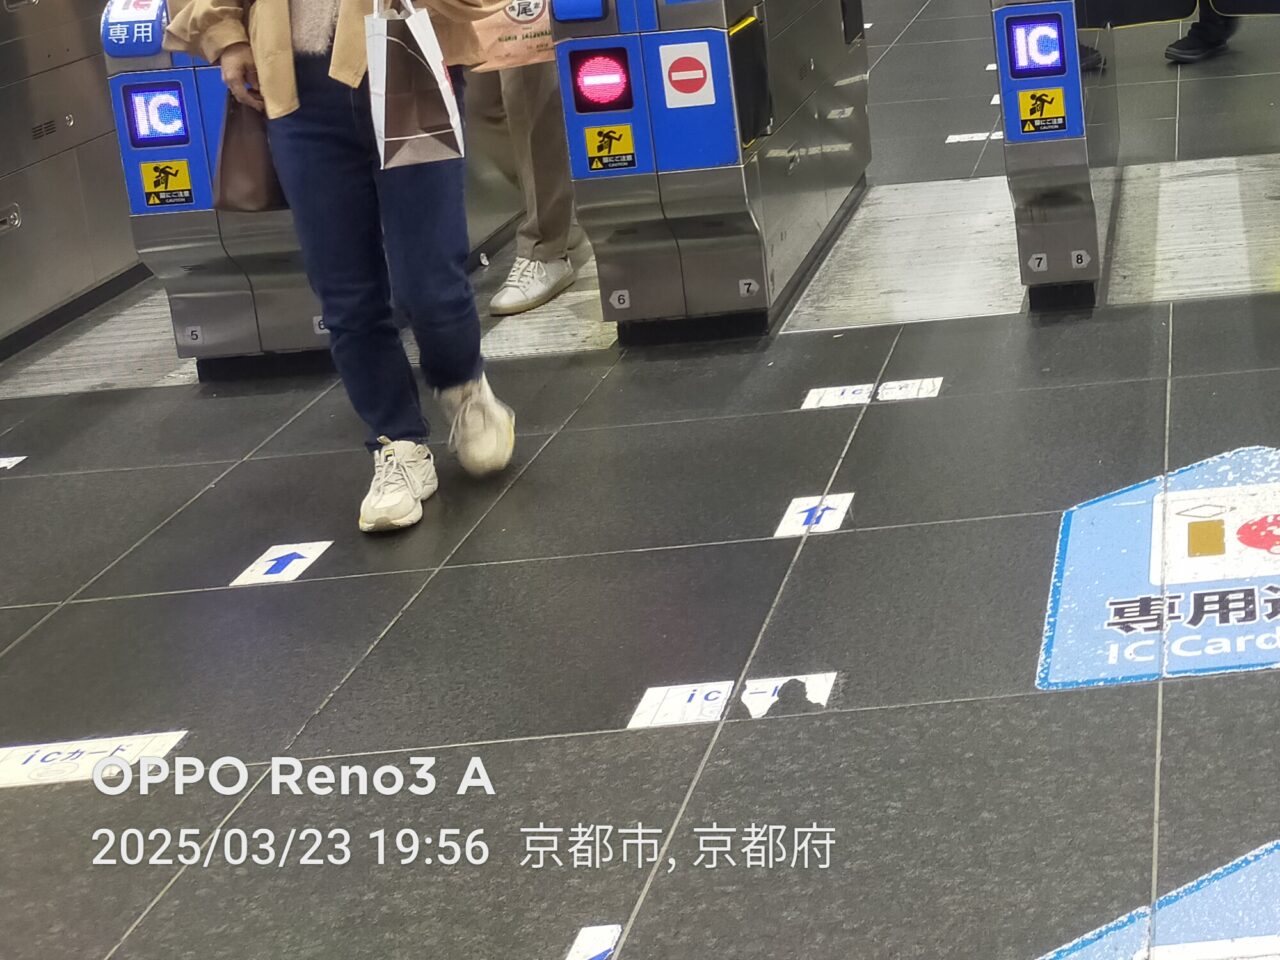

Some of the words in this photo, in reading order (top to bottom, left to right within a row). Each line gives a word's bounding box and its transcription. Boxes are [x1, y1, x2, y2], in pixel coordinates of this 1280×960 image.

[108, 22, 153, 45] 専用
[1015, 25, 1060, 67] IC
[132, 93, 182, 138] IC
[1034, 257, 1043, 268] 7
[1075, 253, 1084, 265] 8
[743, 282, 752, 294] 7
[617, 294, 626, 305] 6
[190, 330, 199, 341] 5
[1106, 640, 1155, 665] IC
